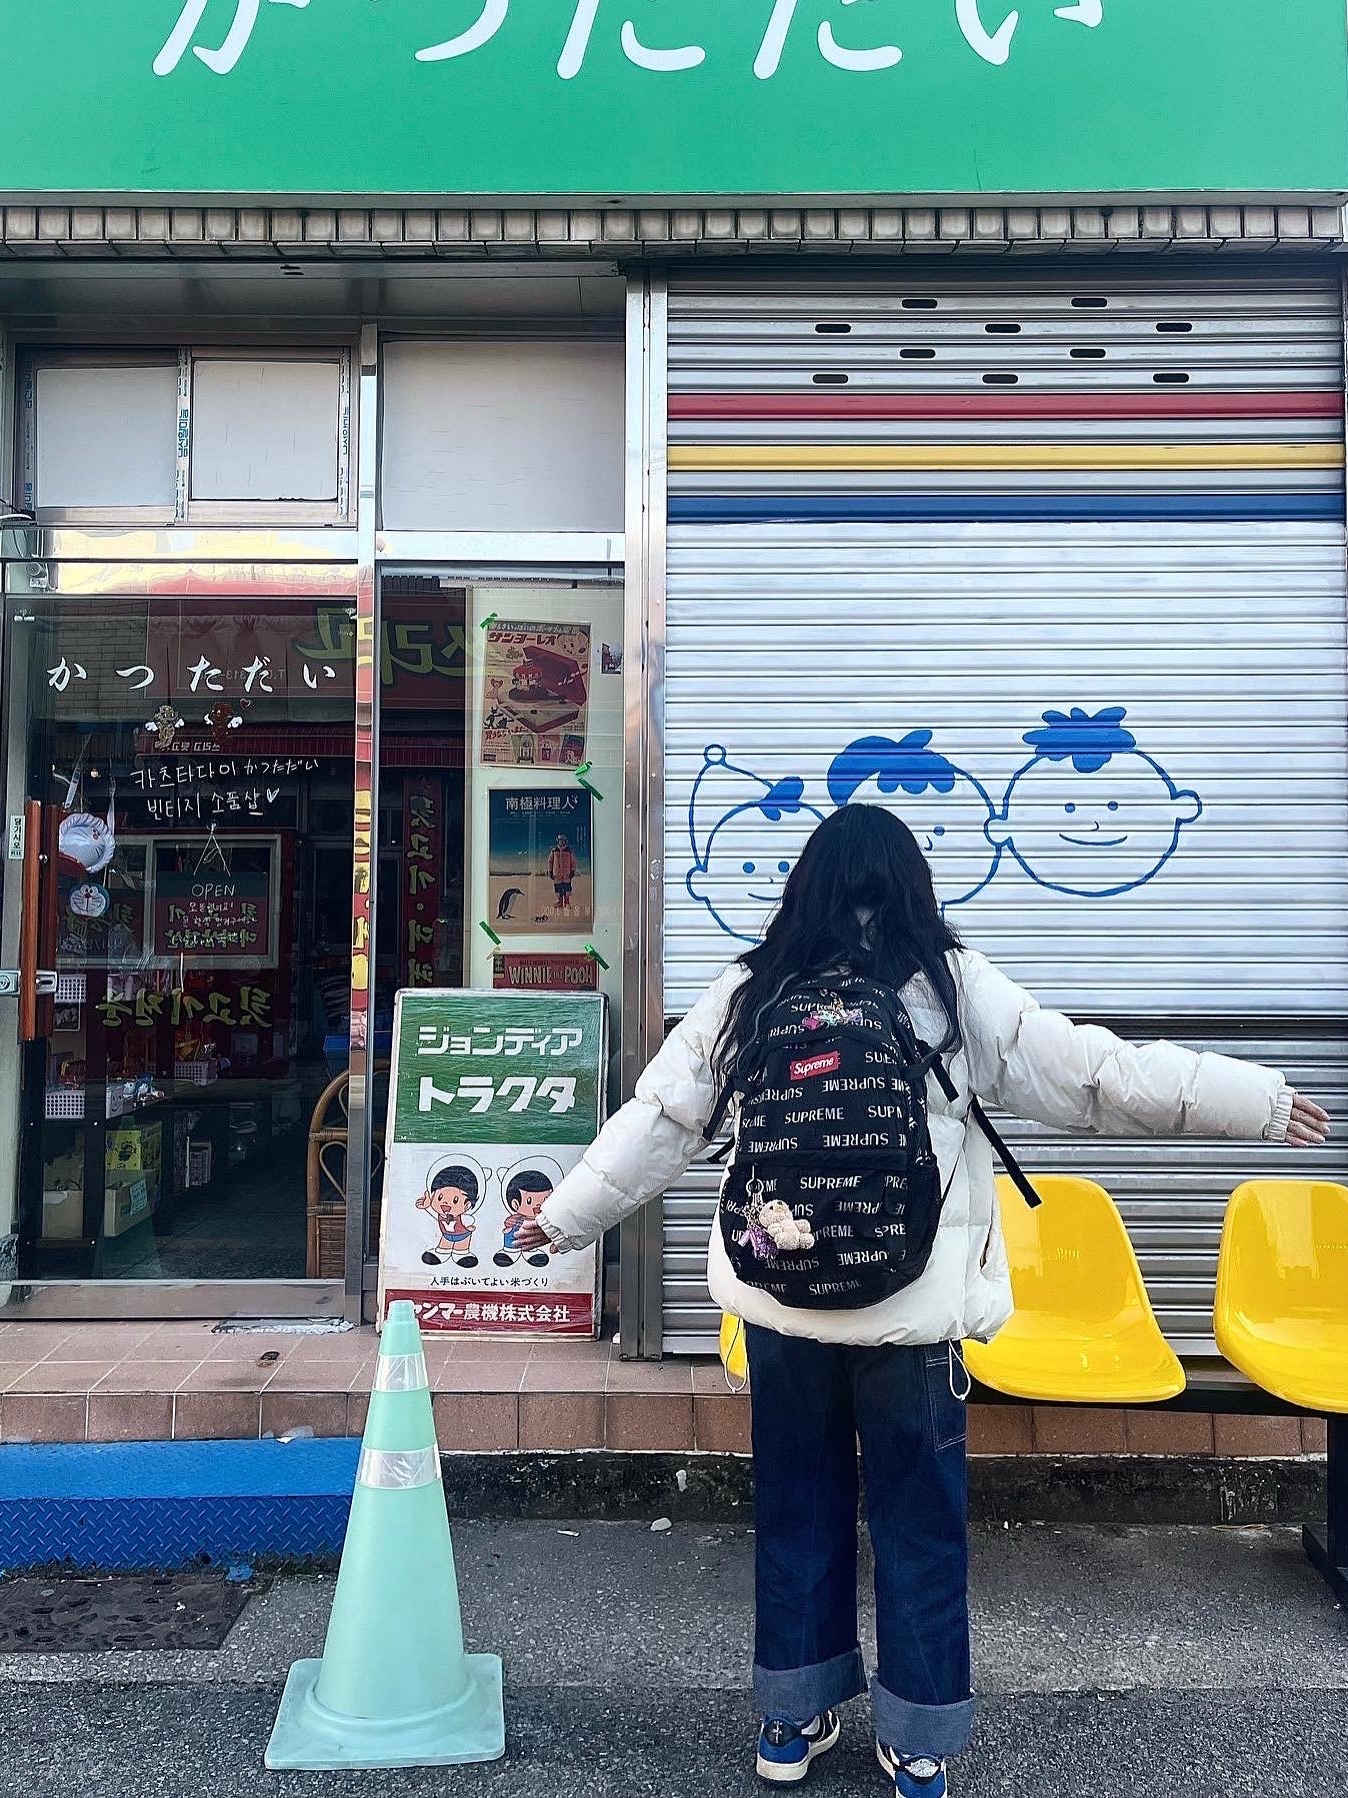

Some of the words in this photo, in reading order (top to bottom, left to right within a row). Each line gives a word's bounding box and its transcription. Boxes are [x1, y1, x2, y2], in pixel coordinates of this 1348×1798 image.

[46, 654, 338, 693] かつただい
[130, 764, 237, 791] 카츠타다이
[147, 791, 201, 820] 빈티지
[505, 796, 576, 811] 南極料理人
[13, 817, 22, 849] 당기시오
[191, 883, 236, 900] OPEN
[508, 966, 552, 985] WINNIE
[564, 966, 593, 985] POOH
[418, 1025, 583, 1057] ジョンディア
[792, 1056, 835, 1076] Supreme
[822, 1076, 886, 1093] SUPREME
[418, 1075, 577, 1114] トラクタ
[784, 1107, 845, 1125] SUPREME
[747, 1137, 799, 1154] SUPREME
[822, 1132, 889, 1148] SUPREME
[800, 1175, 863, 1190] SUPREME
[430, 1275, 549, 1288] 人手はぶいてよい米づくり
[808, 1279, 862, 1296] SUPREME
